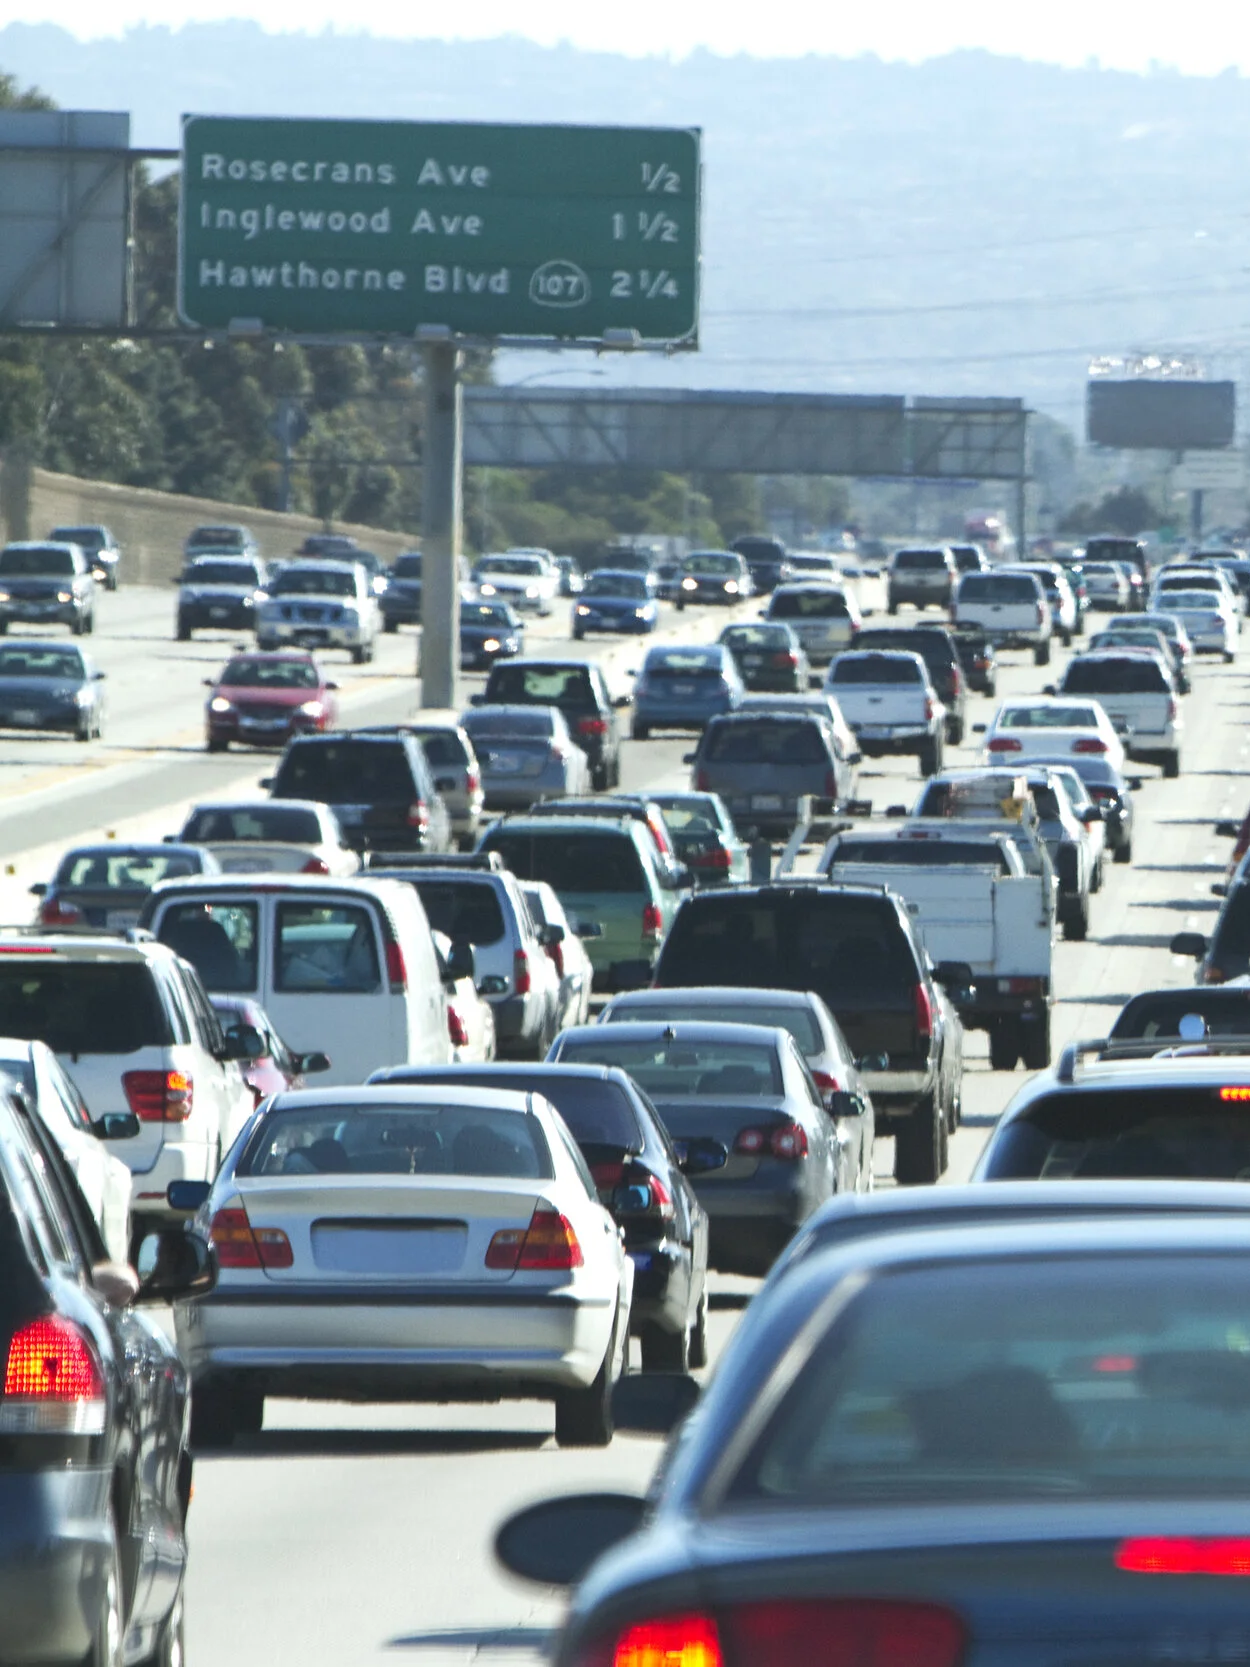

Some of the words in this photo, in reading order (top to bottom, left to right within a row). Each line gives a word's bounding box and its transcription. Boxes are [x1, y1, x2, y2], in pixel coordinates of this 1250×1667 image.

[201, 152, 396, 186] Rosecrans
[416, 157, 492, 188] Ave
[200, 201, 391, 240] Inglewood
[410, 208, 484, 236] Ave
[199, 258, 406, 292] Hawthorne
[424, 263, 511, 294] Blvd
[538, 274, 580, 297] 107
